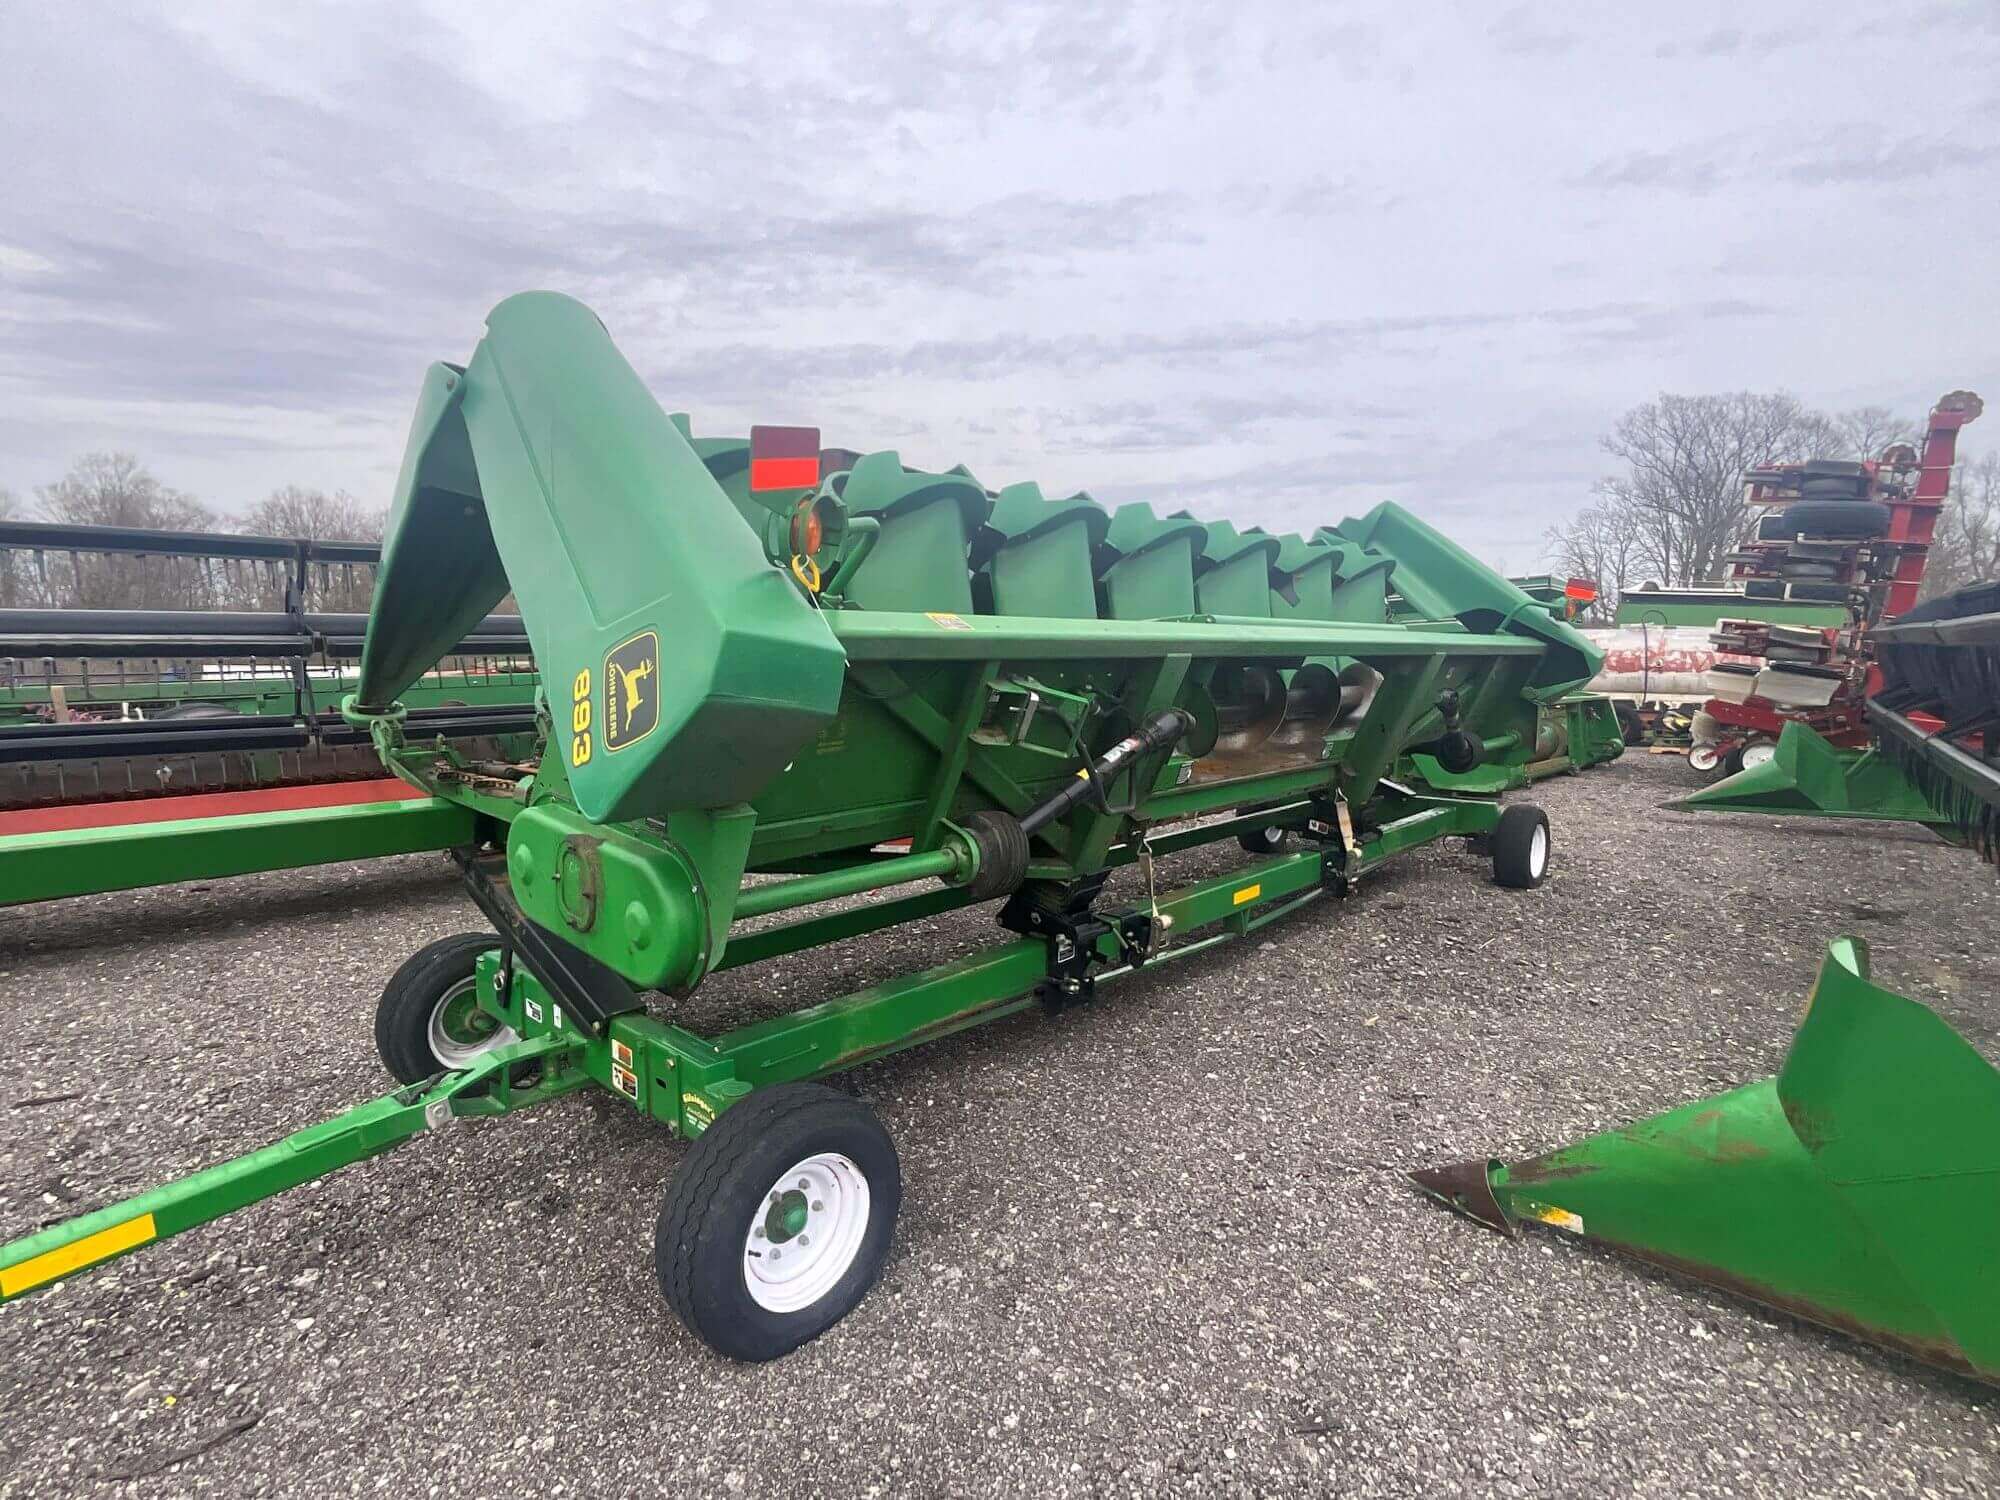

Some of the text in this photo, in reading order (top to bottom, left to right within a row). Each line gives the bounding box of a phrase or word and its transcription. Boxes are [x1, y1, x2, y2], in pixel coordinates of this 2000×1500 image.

[572, 668, 592, 768] 893
[608, 662, 618, 740] JOHN DEERE
